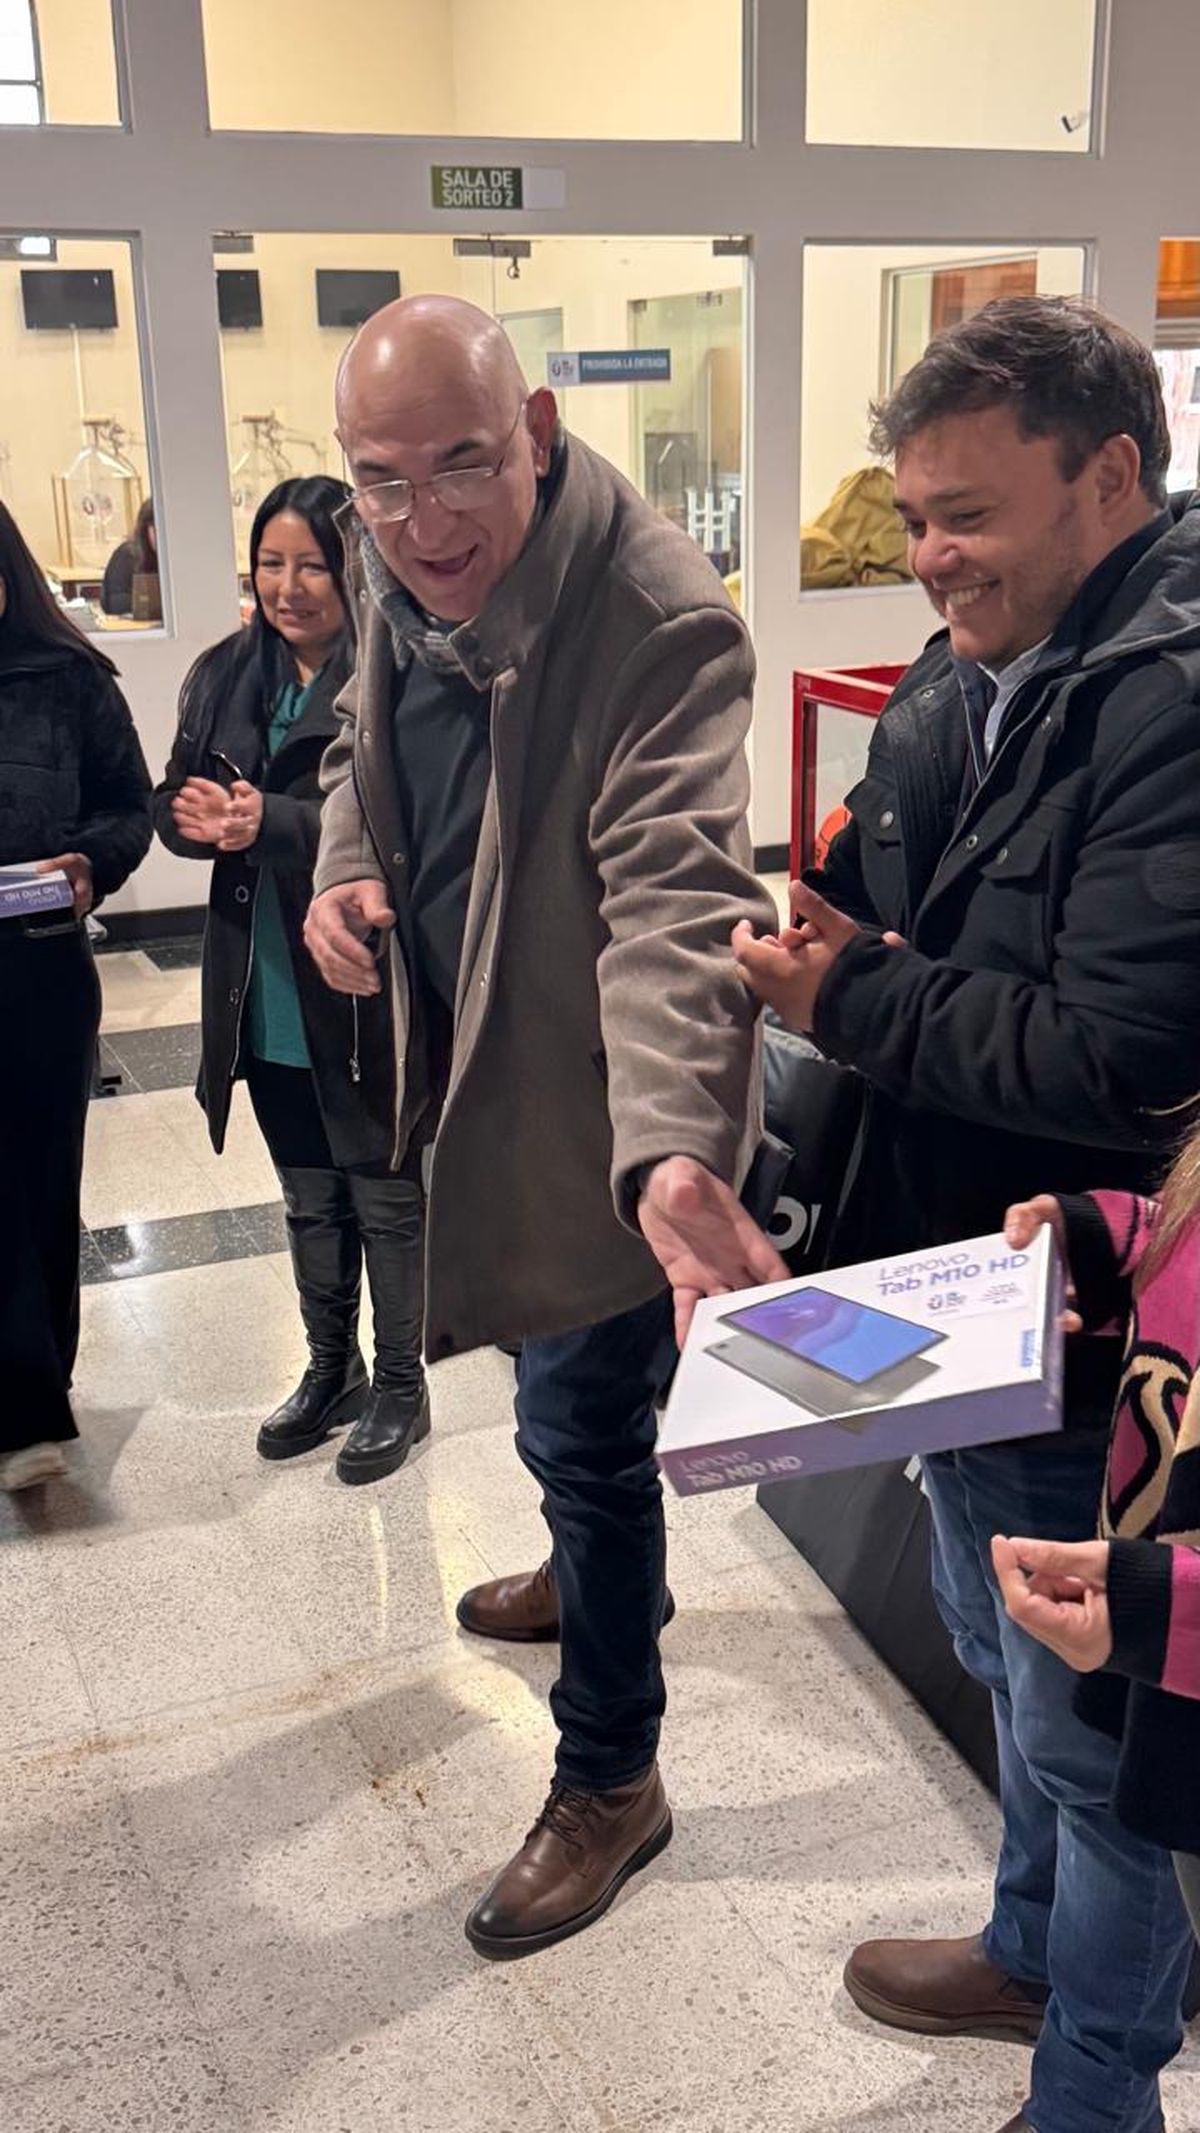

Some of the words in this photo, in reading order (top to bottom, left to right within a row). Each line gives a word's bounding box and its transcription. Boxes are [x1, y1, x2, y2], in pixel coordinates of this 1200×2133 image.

[442, 170, 487, 188] SALA
[490, 170, 513, 188] DE
[442, 188, 502, 207] SORTEO
[505, 190, 514, 207] 2
[878, 1277, 923, 1296] Tab
[929, 1264, 981, 1286] M10
[988, 1253, 1030, 1273] HD
[879, 1252, 970, 1281] Lenovo
[685, 1470, 726, 1487] Tab
[725, 1461, 768, 1481] M10
[767, 1455, 802, 1473] HD
